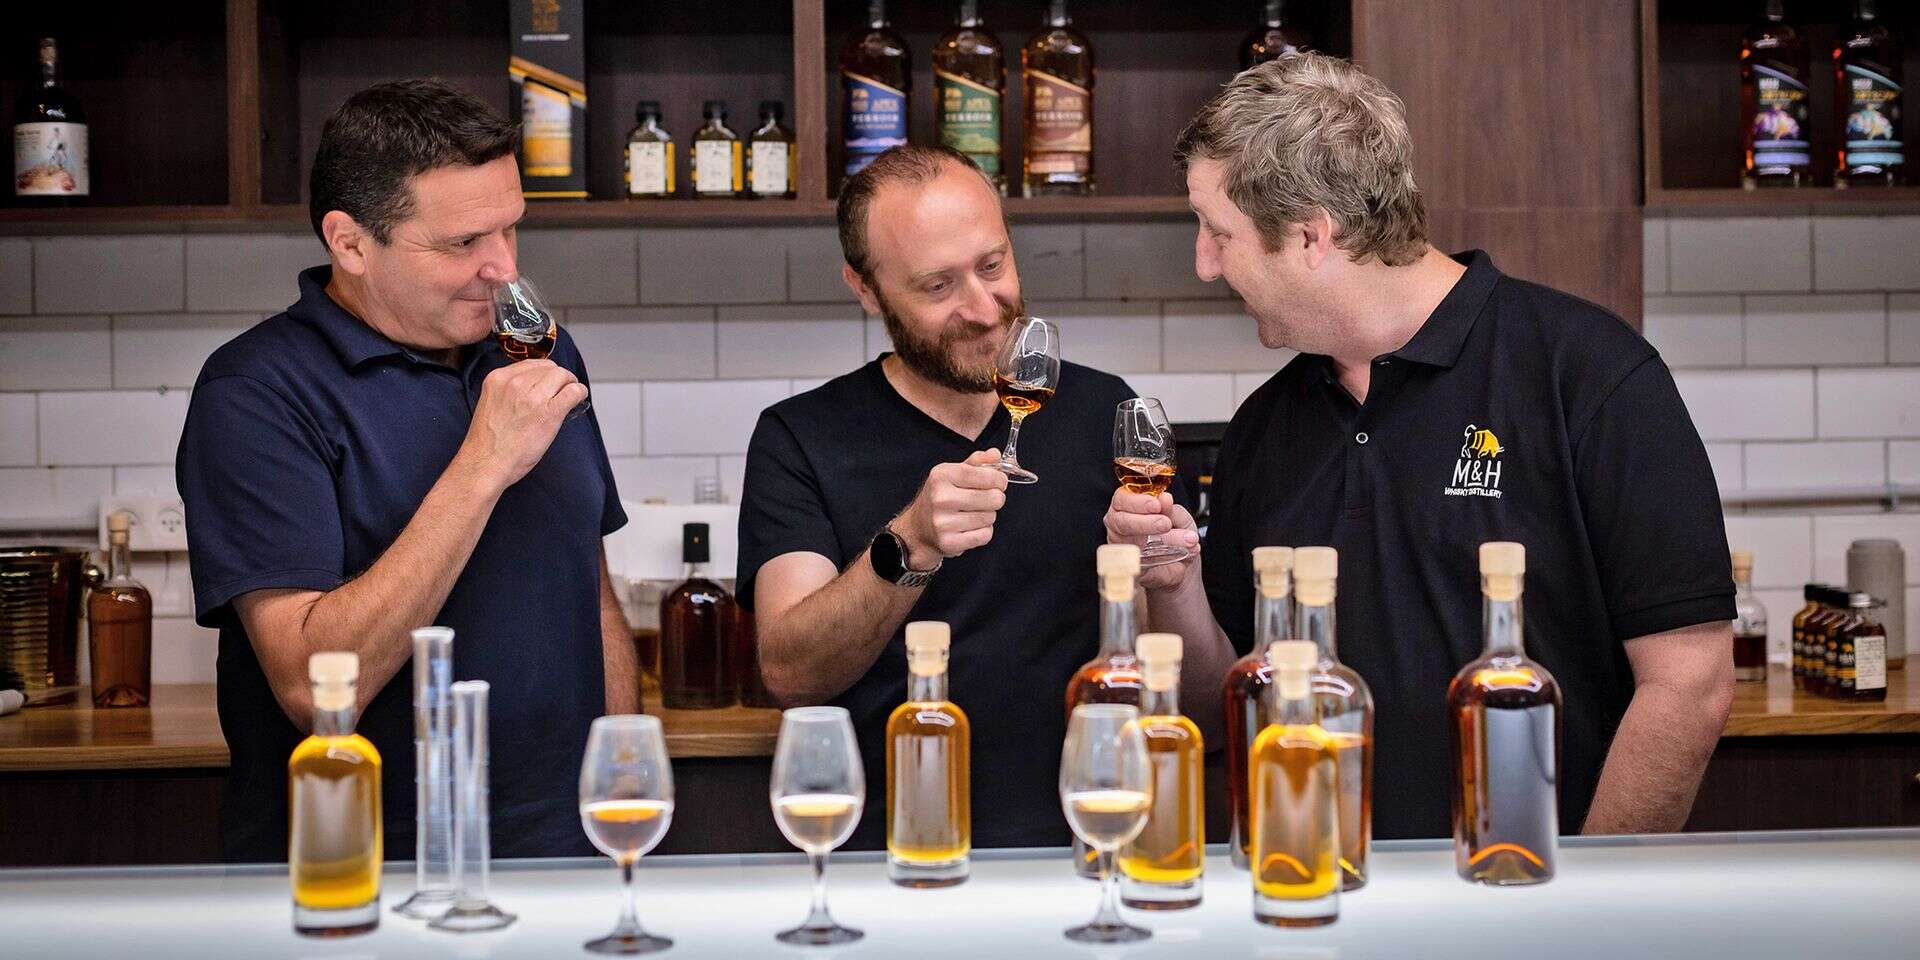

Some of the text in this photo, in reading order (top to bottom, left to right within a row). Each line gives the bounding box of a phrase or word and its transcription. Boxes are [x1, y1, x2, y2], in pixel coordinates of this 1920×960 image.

[1451, 458, 1502, 488] M&H
[1445, 487, 1502, 499] WHISKY DISTILLERY
